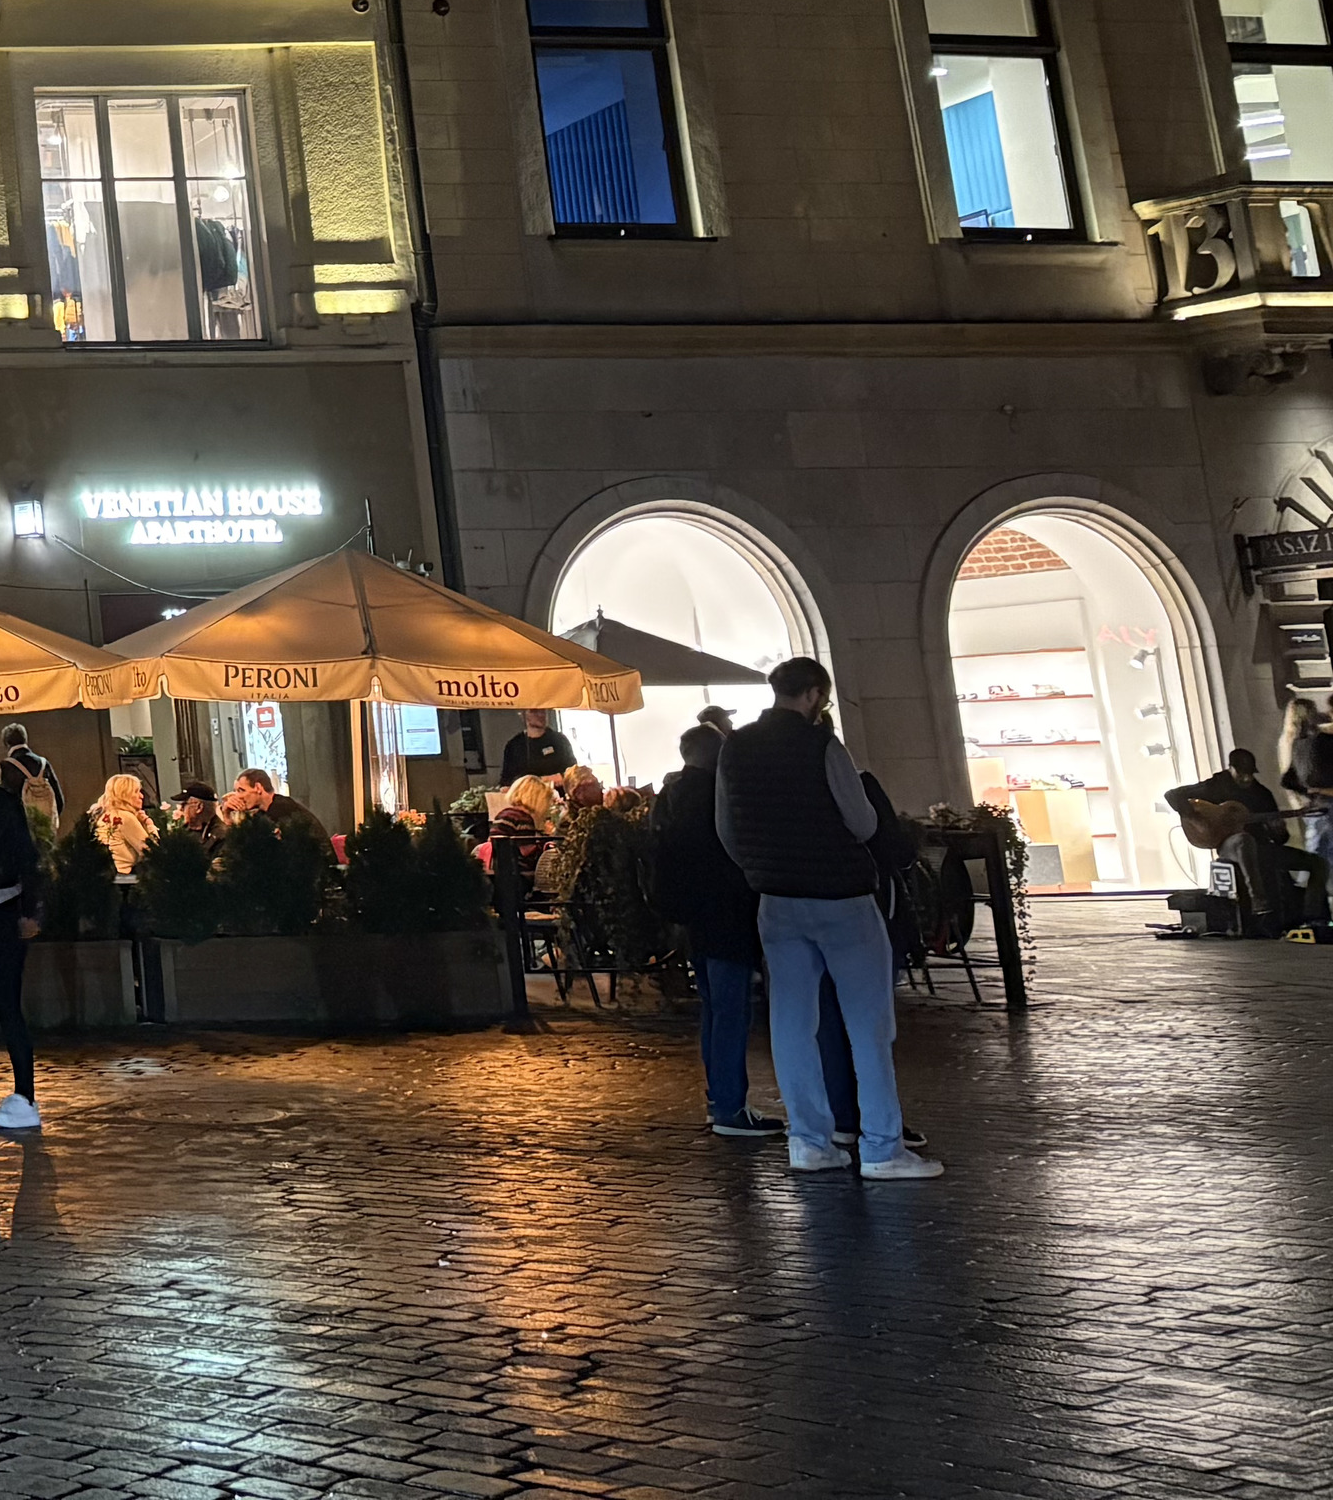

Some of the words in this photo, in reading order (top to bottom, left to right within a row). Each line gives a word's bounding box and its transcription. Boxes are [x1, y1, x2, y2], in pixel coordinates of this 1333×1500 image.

[81, 488, 224, 519] VENETIAN
[226, 486, 323, 516] HOUSE
[130, 520, 284, 544] APARTHOTEL
[224, 665, 318, 688] PERONI
[435, 674, 519, 698] molto
[250, 692, 290, 700] ITALIA
